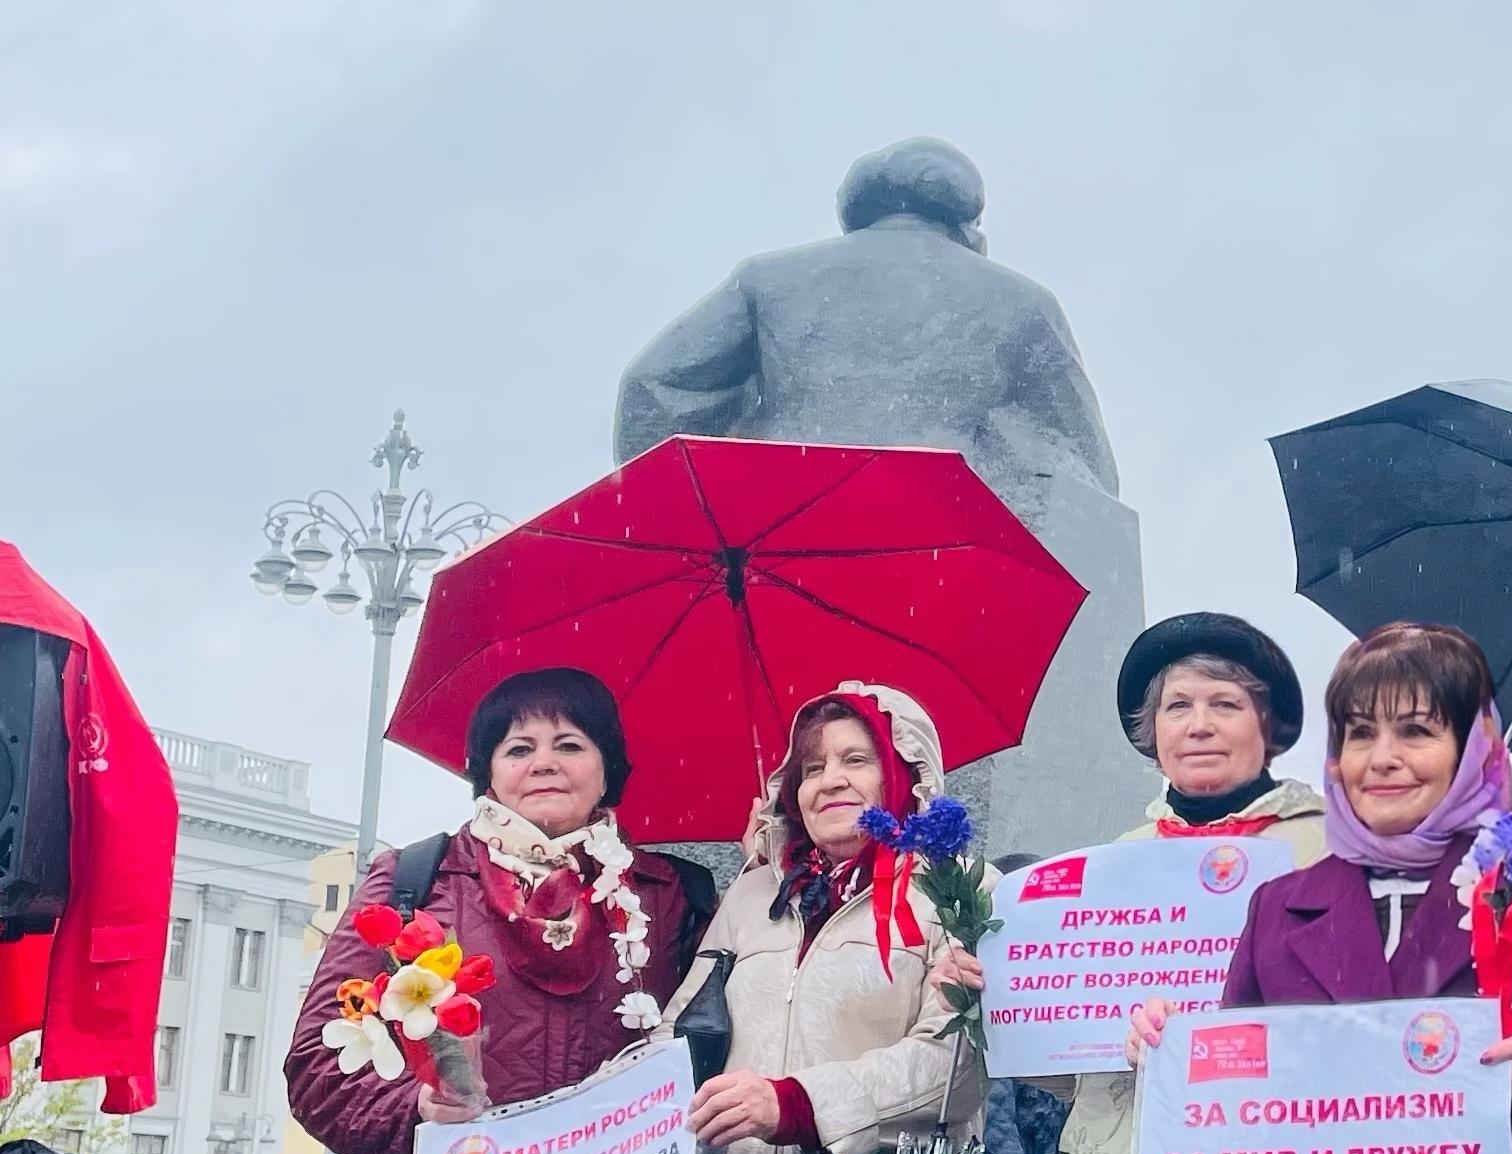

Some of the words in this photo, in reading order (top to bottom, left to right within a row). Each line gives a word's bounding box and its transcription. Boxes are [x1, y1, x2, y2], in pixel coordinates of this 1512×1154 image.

[1061, 907, 1162, 930] ДРУЖБА
[1170, 906, 1186, 922] И
[1008, 941, 1133, 961] БРАТСТВО
[1010, 974, 1077, 991] ЗАЛОГ
[1084, 969, 1227, 988] ВОЗРОЖДЕНИ
[990, 1005, 1122, 1025] МОГУЩЕСТВА
[601, 1081, 675, 1136] РОССИИ
[1184, 1102, 1227, 1128] ЗА
[1240, 1092, 1465, 1128] СОЦИАЛИЗМ!
